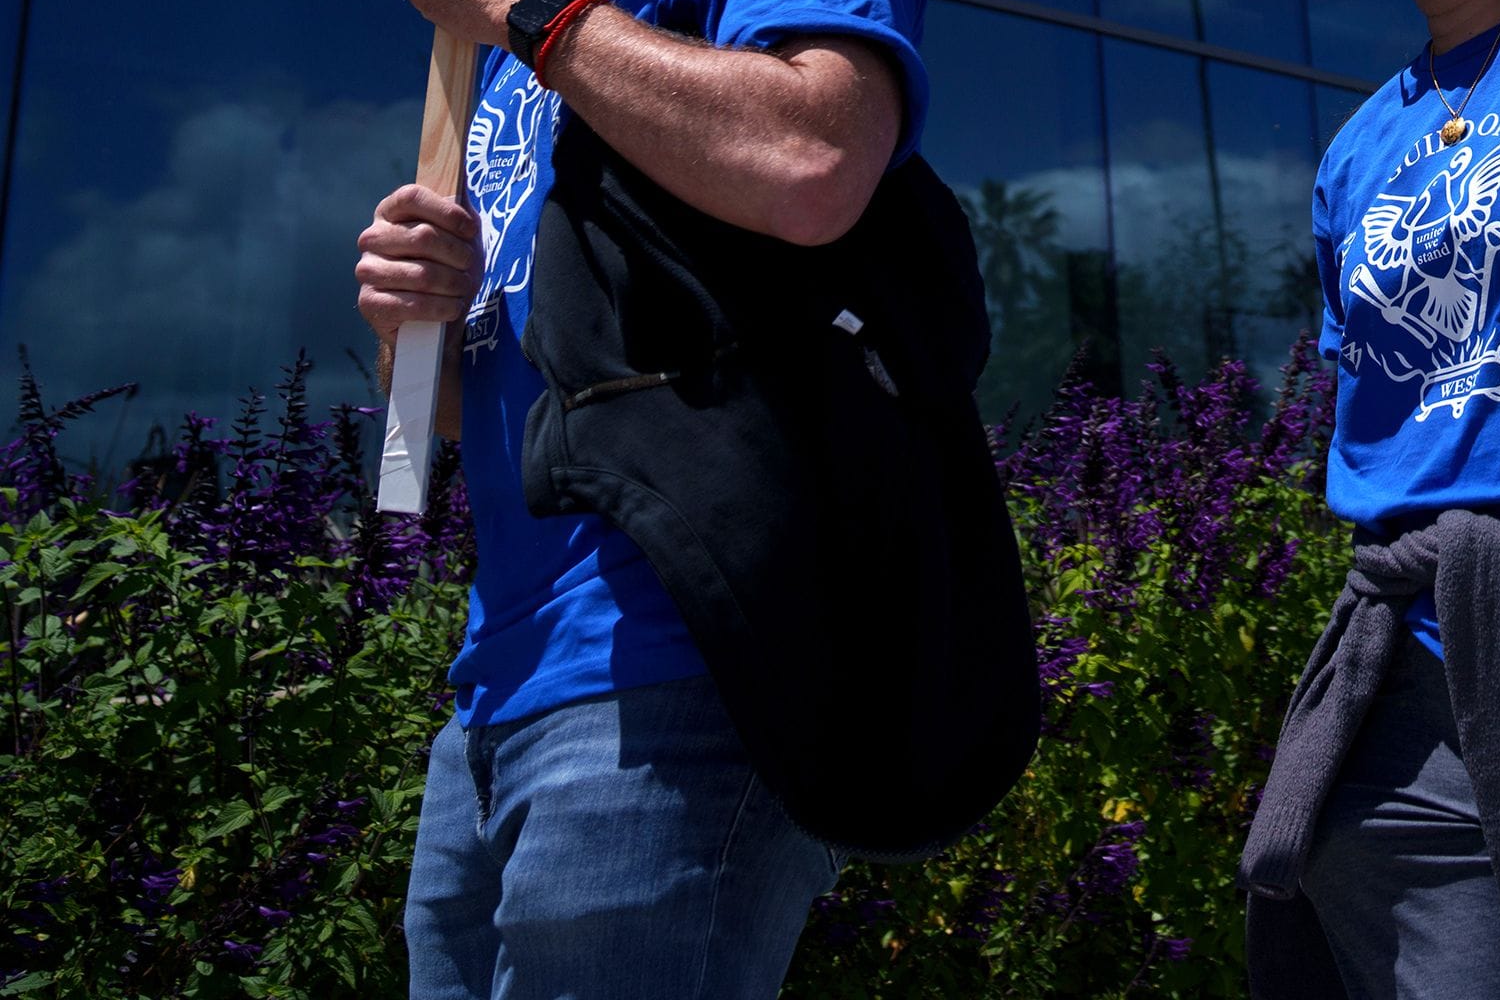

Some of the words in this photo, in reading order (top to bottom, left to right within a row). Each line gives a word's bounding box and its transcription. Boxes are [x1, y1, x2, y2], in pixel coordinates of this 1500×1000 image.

[1417, 242, 1451, 265] stand
[1424, 238, 1439, 250] we
[1441, 371, 1481, 398] WEST
